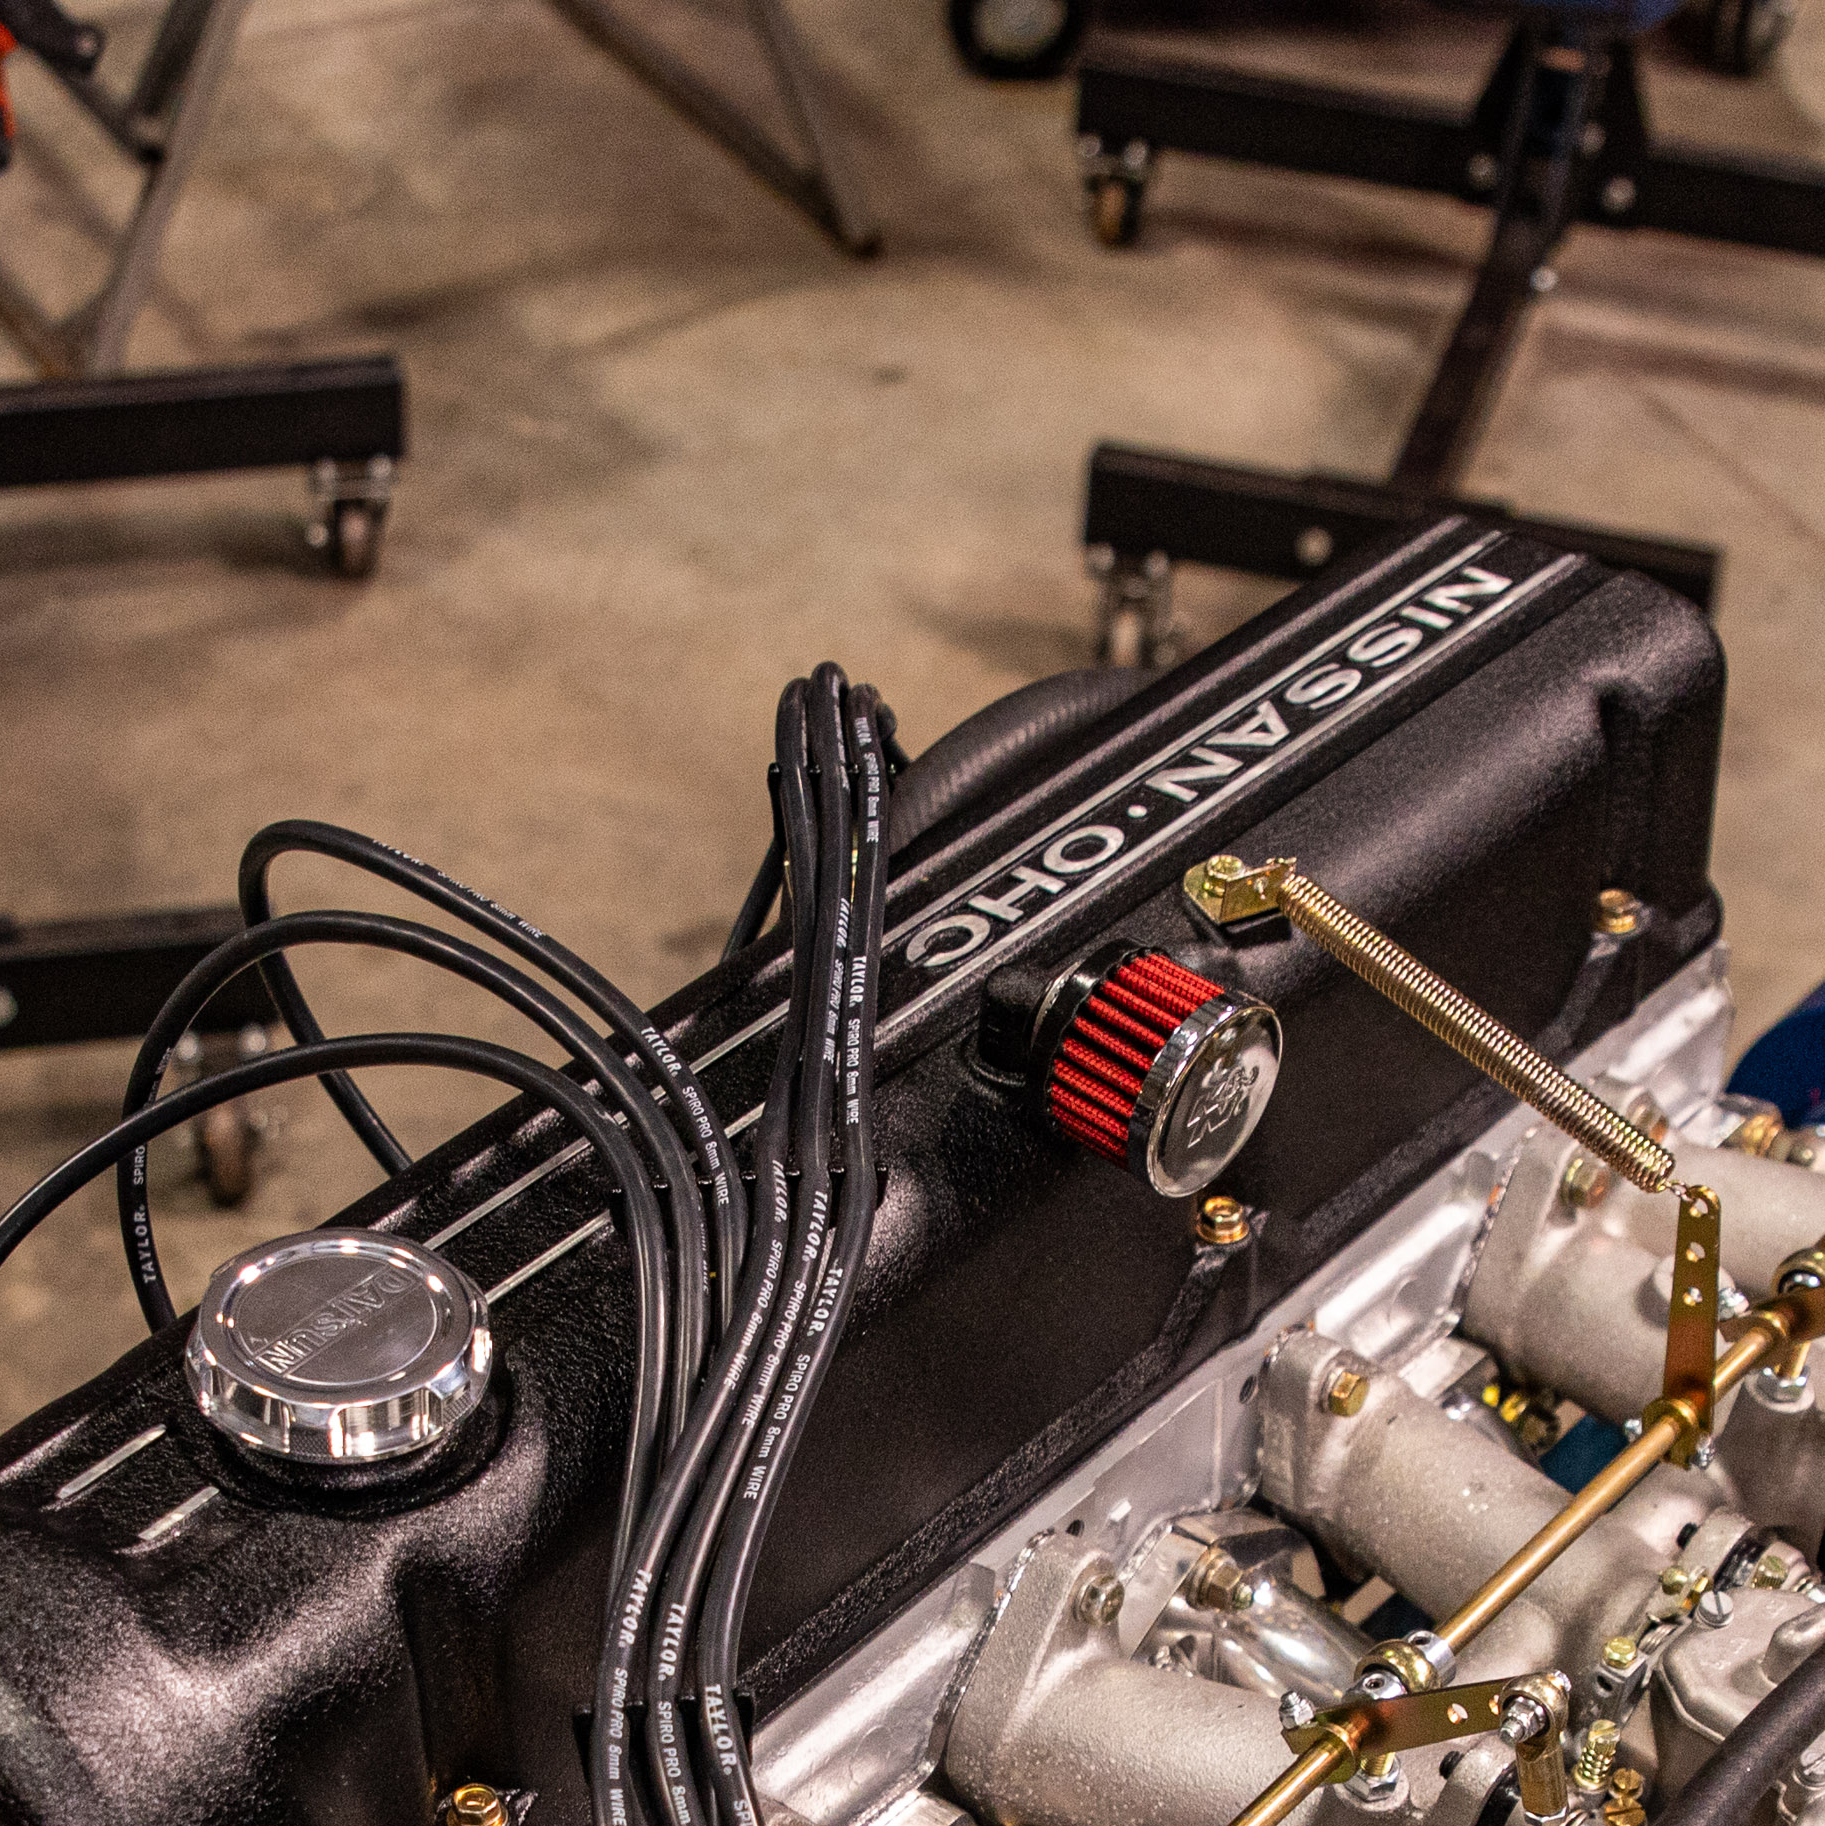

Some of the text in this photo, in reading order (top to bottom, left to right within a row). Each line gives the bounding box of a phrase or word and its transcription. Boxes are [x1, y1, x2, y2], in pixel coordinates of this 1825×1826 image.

[906, 566, 1514, 969] NISSAN OHC
[829, 990, 842, 1010] PRO
[848, 1018, 861, 1049] SPIRO
[846, 1049, 860, 1067] PRO
[846, 1071, 860, 1096] 8mm
[846, 1099, 860, 1125] WIRE
[682, 1085, 705, 1116] SPIRO
[696, 1115, 714, 1139] PRO
[705, 1140, 720, 1170] 8mm
[714, 1172, 729, 1207] WIRE
[133, 1145, 146, 1185] SPIRO
[766, 1239, 783, 1280] SPIRO
[757, 1278, 774, 1309] PRO
[785, 1279, 807, 1321] SPIRO
[741, 1311, 763, 1347] 8mm
[774, 1319, 792, 1351] PRO
[723, 1352, 748, 1390] WIRE
[758, 1354, 781, 1387] 8mm
[785, 1354, 811, 1392] SPIRO
[742, 1393, 766, 1429] WIRE
[774, 1394, 794, 1421] PRO
[758, 1426, 781, 1458] 8mm
[743, 1464, 766, 1500] WIRE
[612, 1667, 628, 1709] SPIRO
[609, 1709, 624, 1739] PRO
[658, 1701, 675, 1744] SPIRO
[608, 1744, 623, 1780] 8mm
[663, 1747, 681, 1779] PRO
[672, 1785, 692, 1826] 8mm
